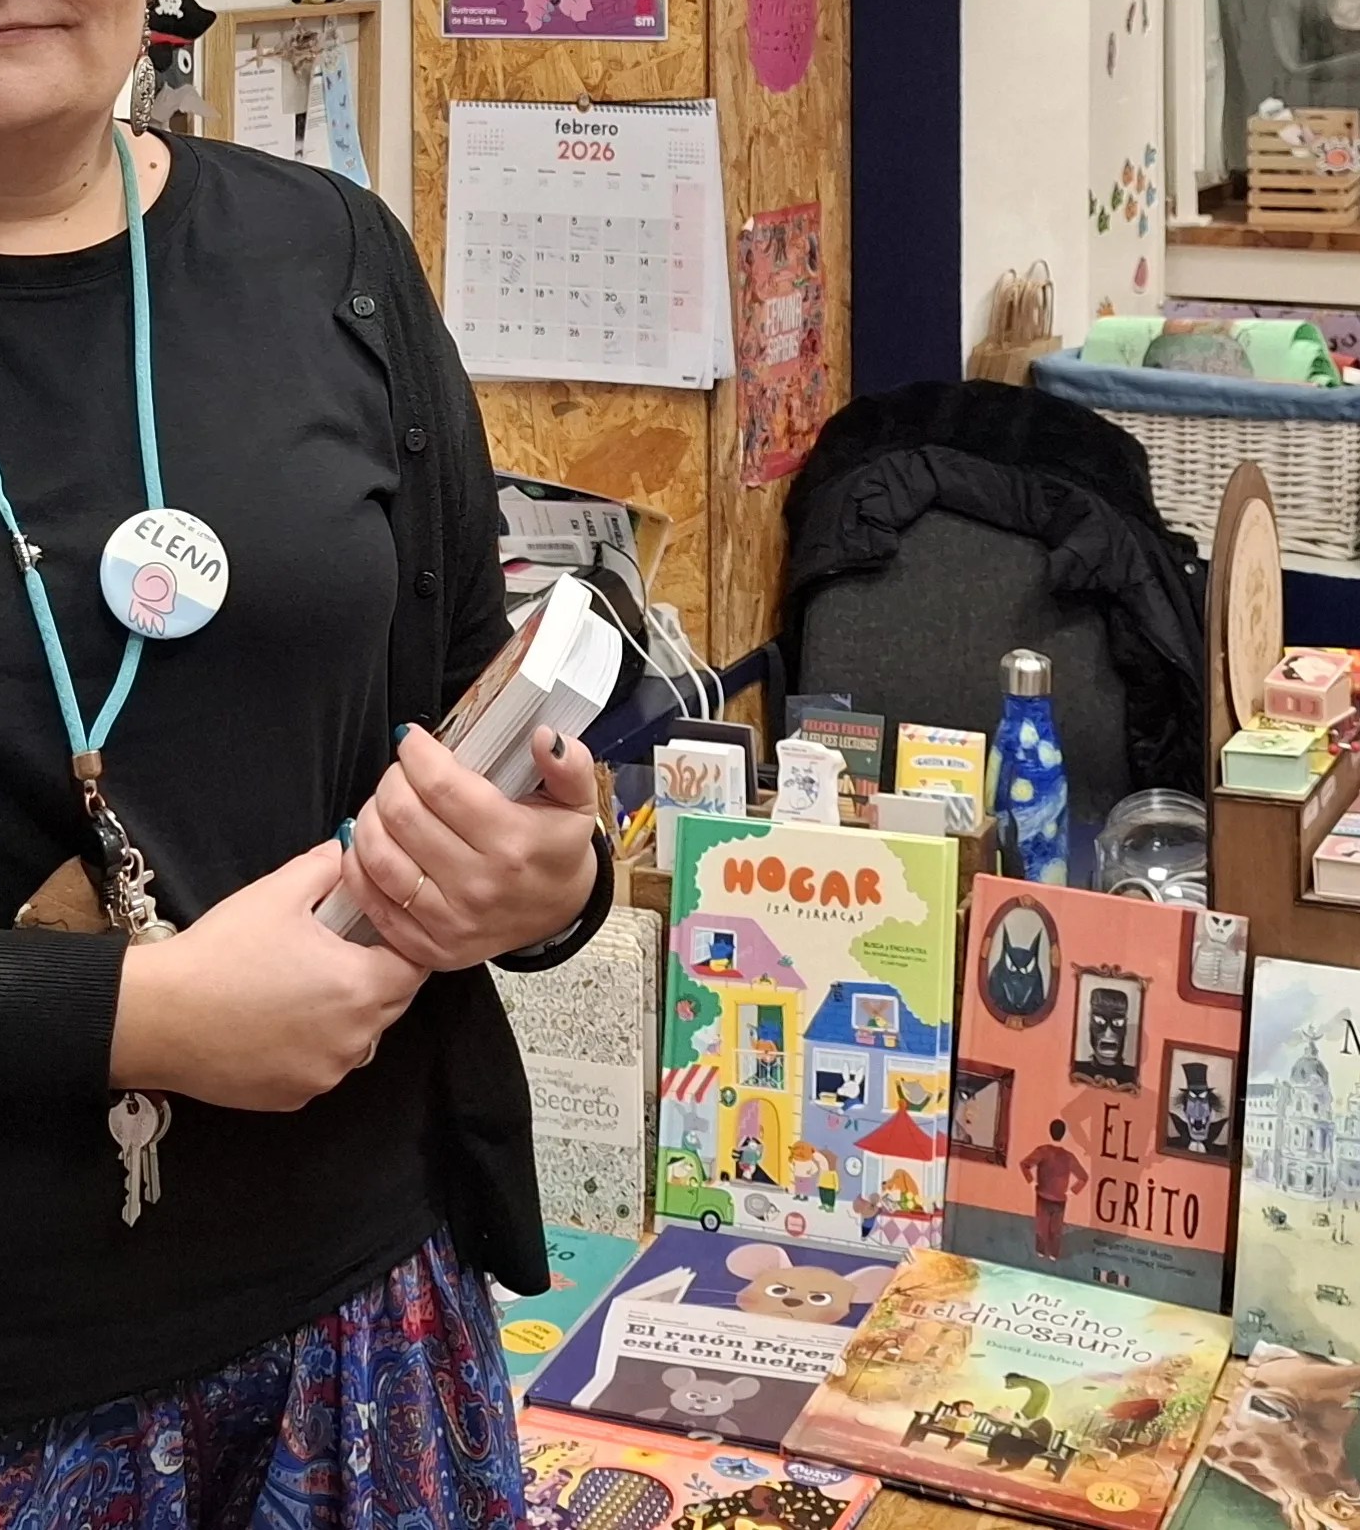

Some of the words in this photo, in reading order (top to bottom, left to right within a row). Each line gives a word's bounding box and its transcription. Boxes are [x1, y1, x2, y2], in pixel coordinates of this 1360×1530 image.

[634, 16, 656, 28] sm
[554, 118, 620, 136] febrero
[557, 139, 616, 162] 2026
[134, 516, 222, 583] ELENA
[722, 855, 883, 910] HOGAR
[766, 902, 791, 916] ISA
[797, 908, 864, 924] PIRRACAS
[534, 1085, 620, 1121] Secreto
[1099, 1102, 1140, 1164] EL
[1026, 1292, 1063, 1309] mi
[932, 1303, 954, 1319] el
[958, 1302, 1153, 1363] dinosaurio
[1010, 1301, 1124, 1338] vecino
[622, 1336, 680, 1353] está
[689, 1346, 722, 1360] en
[730, 1349, 828, 1374] huelga
[625, 1322, 656, 1337] El
[664, 1329, 744, 1350] ratón
[751, 1339, 837, 1361] Pérez
[985, 1339, 1022, 1354] David
[1093, 1490, 1129, 1507] SAL
